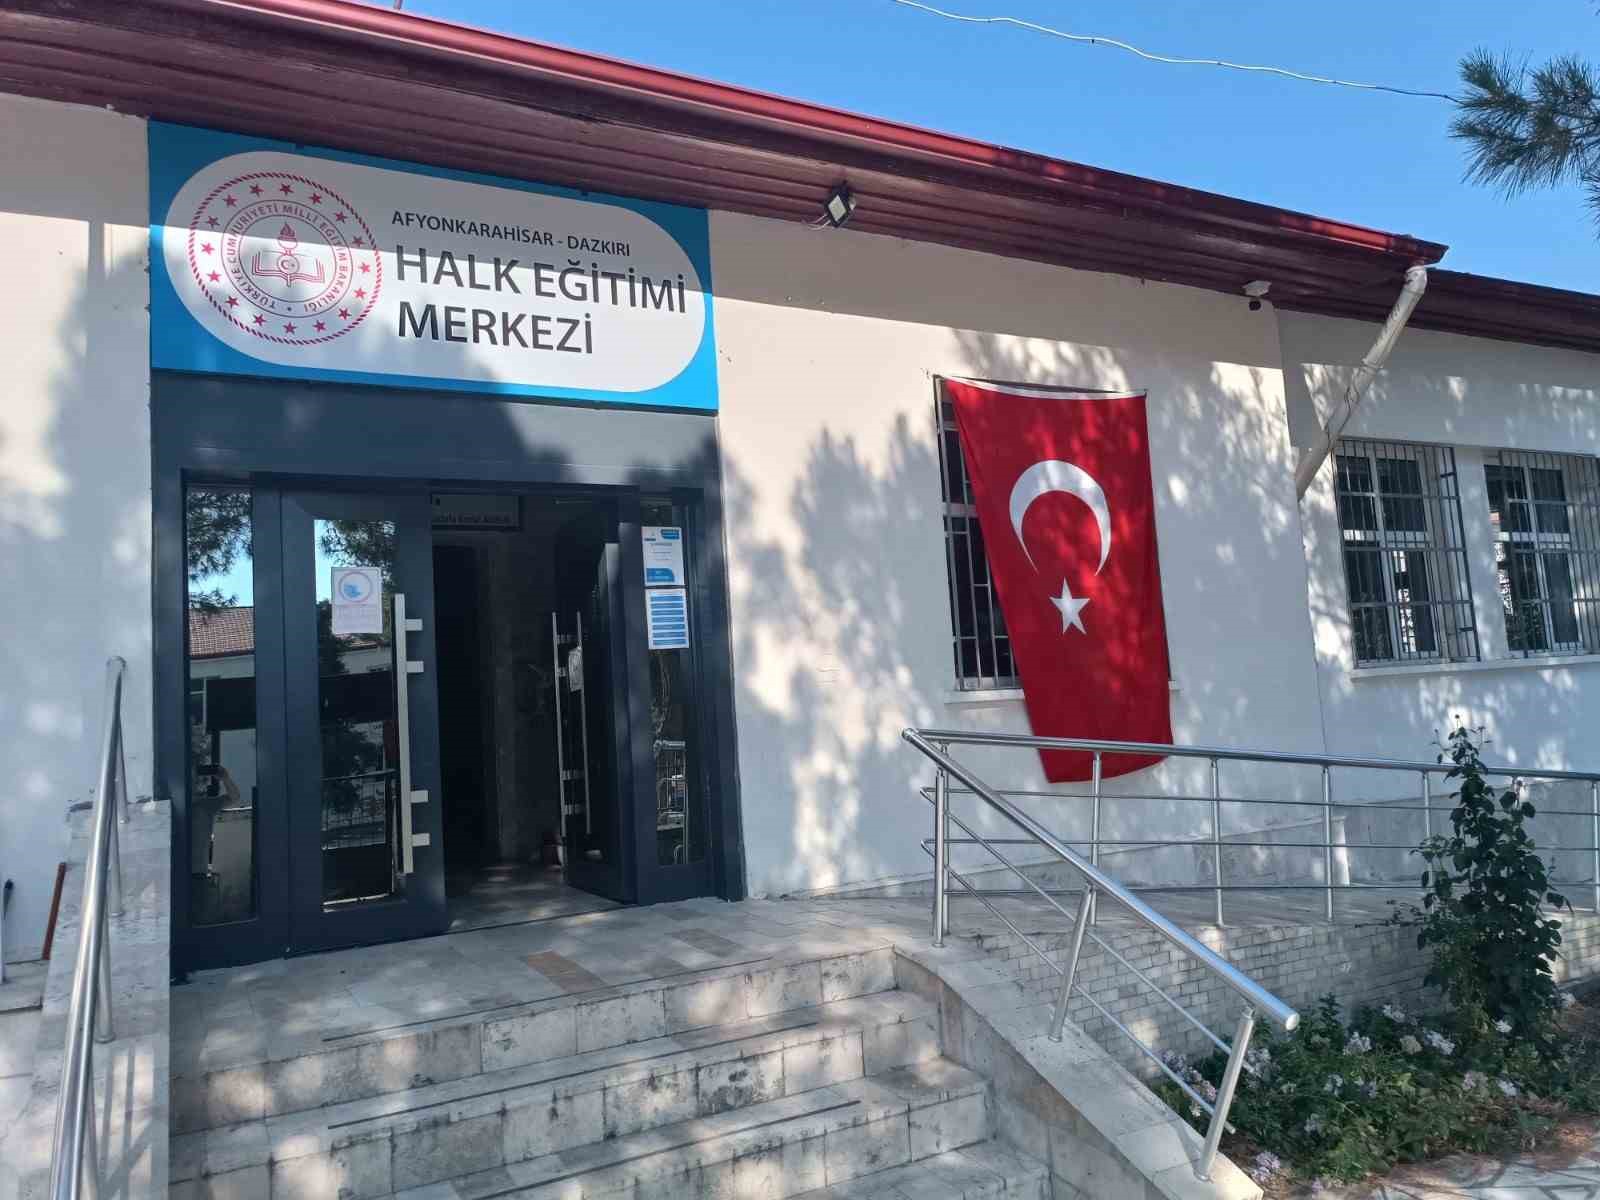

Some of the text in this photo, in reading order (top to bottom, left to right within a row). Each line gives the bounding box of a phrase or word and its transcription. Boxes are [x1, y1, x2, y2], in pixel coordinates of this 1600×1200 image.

[392, 210, 553, 246] AFYONKARAHİSAR
[567, 235, 630, 257] DAZKIRI
[395, 244, 686, 313] HALK EĞİTİMİ
[398, 301, 593, 354] MERKEZİ
